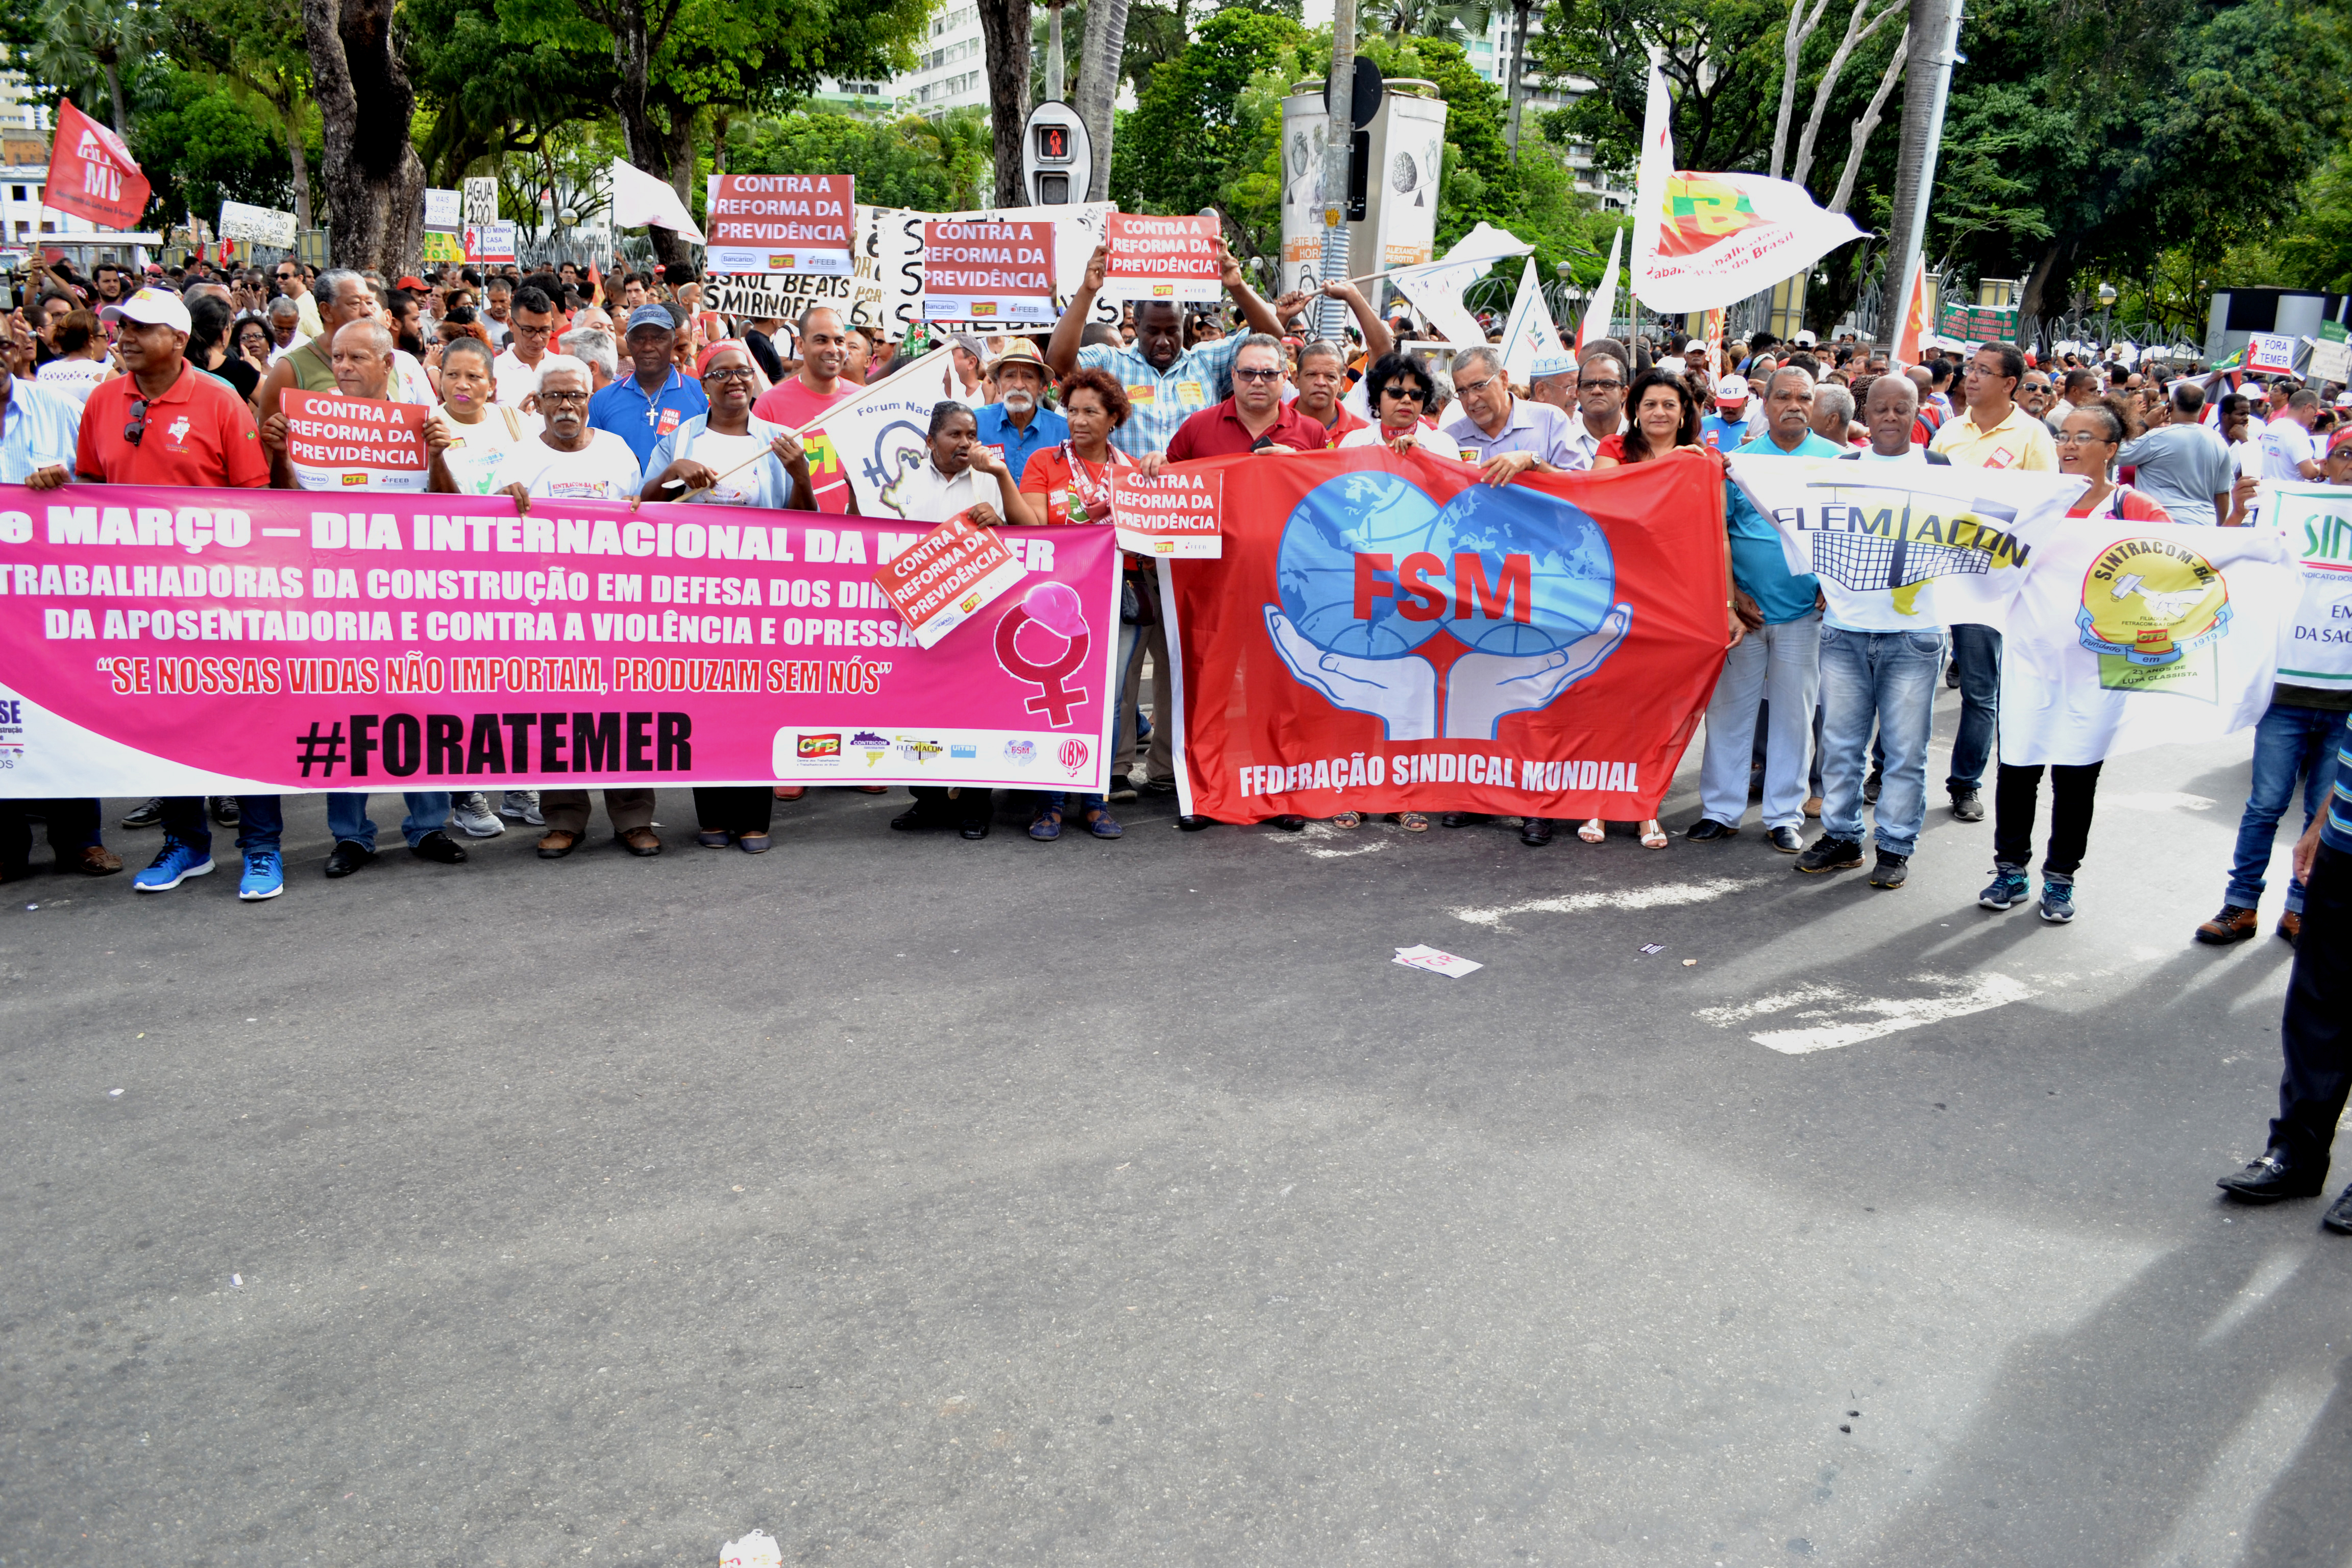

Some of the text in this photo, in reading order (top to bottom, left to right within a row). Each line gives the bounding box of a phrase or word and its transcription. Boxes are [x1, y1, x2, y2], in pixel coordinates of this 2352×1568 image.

[466, 177, 494, 202] ÁGUA
[733, 176, 831, 192] CONTRA A
[426, 205, 457, 214] PROJETOS
[717, 199, 843, 216] REFORMA DA
[717, 221, 846, 241] PREVIDÊNCIA
[935, 224, 1015, 240] CONTRA
[1019, 224, 1033, 240] A
[1123, 220, 1202, 235] CONTRA A
[1113, 237, 1212, 253] REFORMA DA
[1752, 231, 1794, 259] Brasil
[770, 257, 794, 266] CTB
[925, 247, 1045, 264] REFORMA DA
[1386, 254, 1414, 263] PEROTTO
[1112, 256, 1214, 273] PREVIDÊNCIA
[1154, 286, 1172, 296] CTB
[972, 304, 996, 314] CTB
[2265, 339, 2287, 351] FORA
[2260, 353, 2288, 365] TEMER
[305, 399, 404, 424] CONTRA A
[857, 402, 900, 416] Fórum
[290, 419, 416, 443] REFORMA DA
[292, 440, 419, 464] PREVIDÊNCIA
[343, 475, 366, 483] CTB
[1127, 472, 1204, 488] CONTRA A
[1115, 490, 1214, 509] REFORMA DA
[1117, 512, 1215, 529] PREVIDÊNCIA
[47, 506, 1055, 572] MARÇO DIA INTERNACIONAL DA MER
[894, 520, 967, 577] CONTRA A
[1155, 544, 1173, 552] CTB
[894, 531, 989, 604] REFORMA DA
[2094, 541, 2216, 585] SINTRACOM-BA
[908, 546, 1003, 621] PREVIDÊNCIA
[2301, 572, 2336, 580] NDICATO
[0, 564, 831, 608] TRABALHADORAS DA CONSTRUÇÃO EM DEFESA DOS
[1353, 551, 1531, 624] FSM
[962, 594, 981, 611] CTB
[45, 609, 923, 647] DA APOSENTADORIA E CONTRA A VIOLÊNCIA E OPRESSÃ
[2139, 632, 2168, 641] CTB
[2294, 626, 2317, 642] DA
[2082, 638, 2121, 653] Fundado
[2193, 633, 2217, 647] 1919
[158, 656, 281, 695] NOSSAS
[286, 657, 380, 695] VIDAS
[386, 650, 444, 694] NÃO
[451, 656, 608, 695] IMPORTAM,
[614, 657, 761, 693] PRODUZAM
[767, 660, 822, 693] SEM
[2148, 671, 2198, 681] CLASSISTA
[0, 700, 21, 724] SE
[0, 726, 23, 734] strução
[296, 712, 692, 777] #FORATEMER
[799, 738, 839, 753] CTB
[1059, 741, 1085, 767] UBM
[1239, 751, 1639, 794] FEDERAÇÃO SINDICAL MUNDIAL
